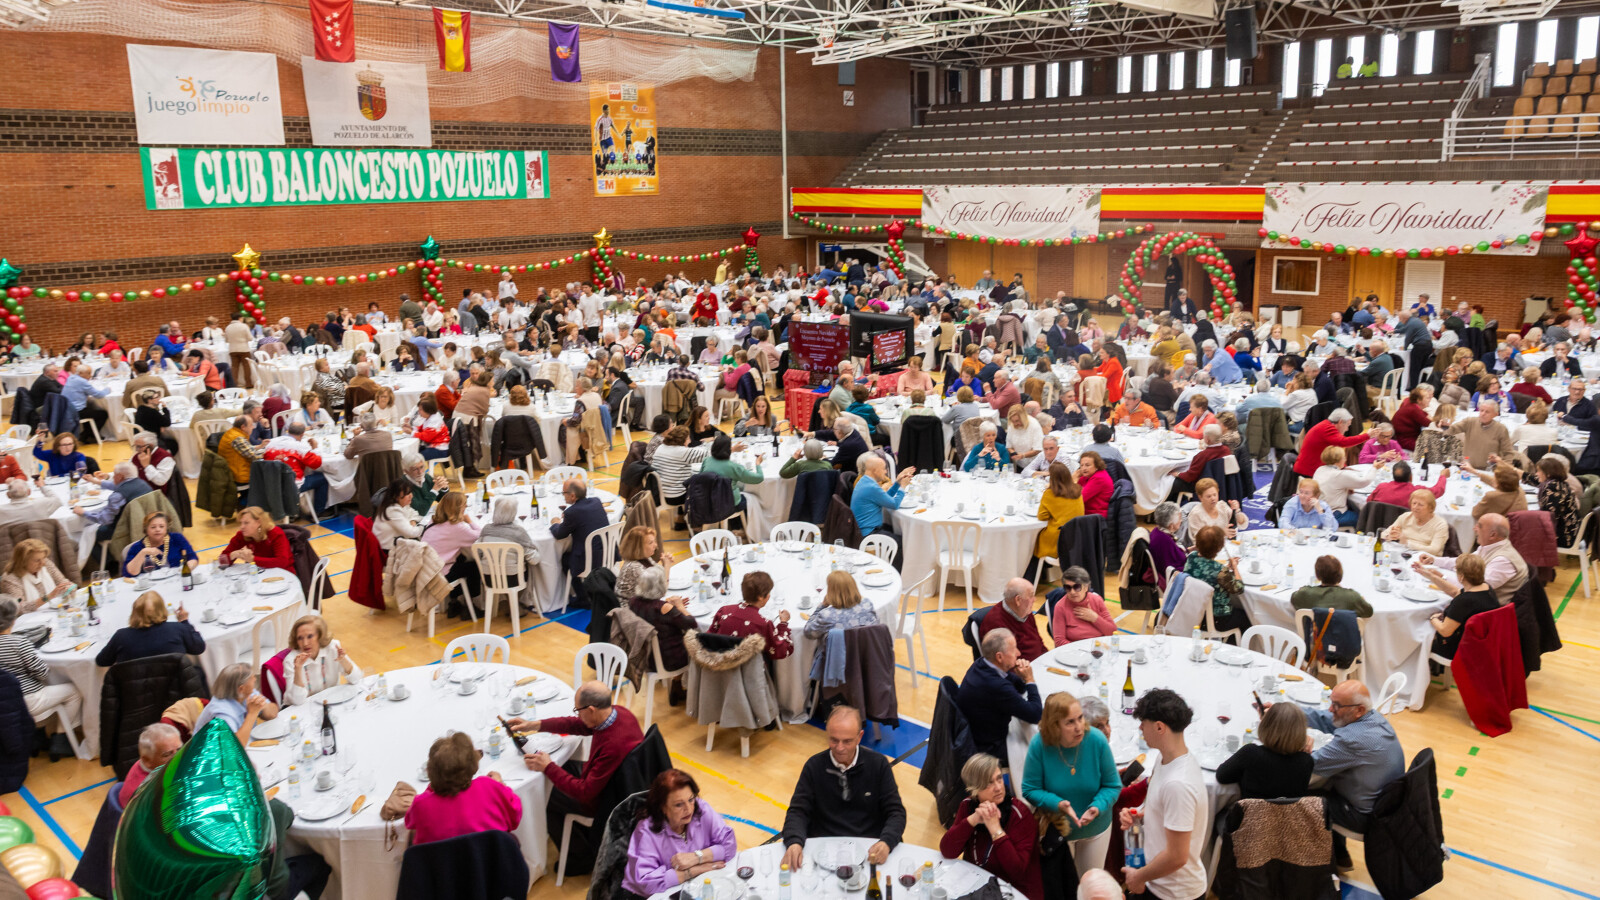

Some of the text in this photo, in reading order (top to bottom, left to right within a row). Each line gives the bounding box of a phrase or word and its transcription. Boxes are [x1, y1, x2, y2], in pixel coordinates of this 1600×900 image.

[147, 92, 250, 117] juegolimpio
[216, 90, 269, 102] Pozuelo
[194, 150, 519, 204] CLUB BALONCESTO POZUELO
[940, 200, 1075, 227] ¡Feliz Navidad!
[1291, 201, 1504, 234] ¡Feliz Navidad!
